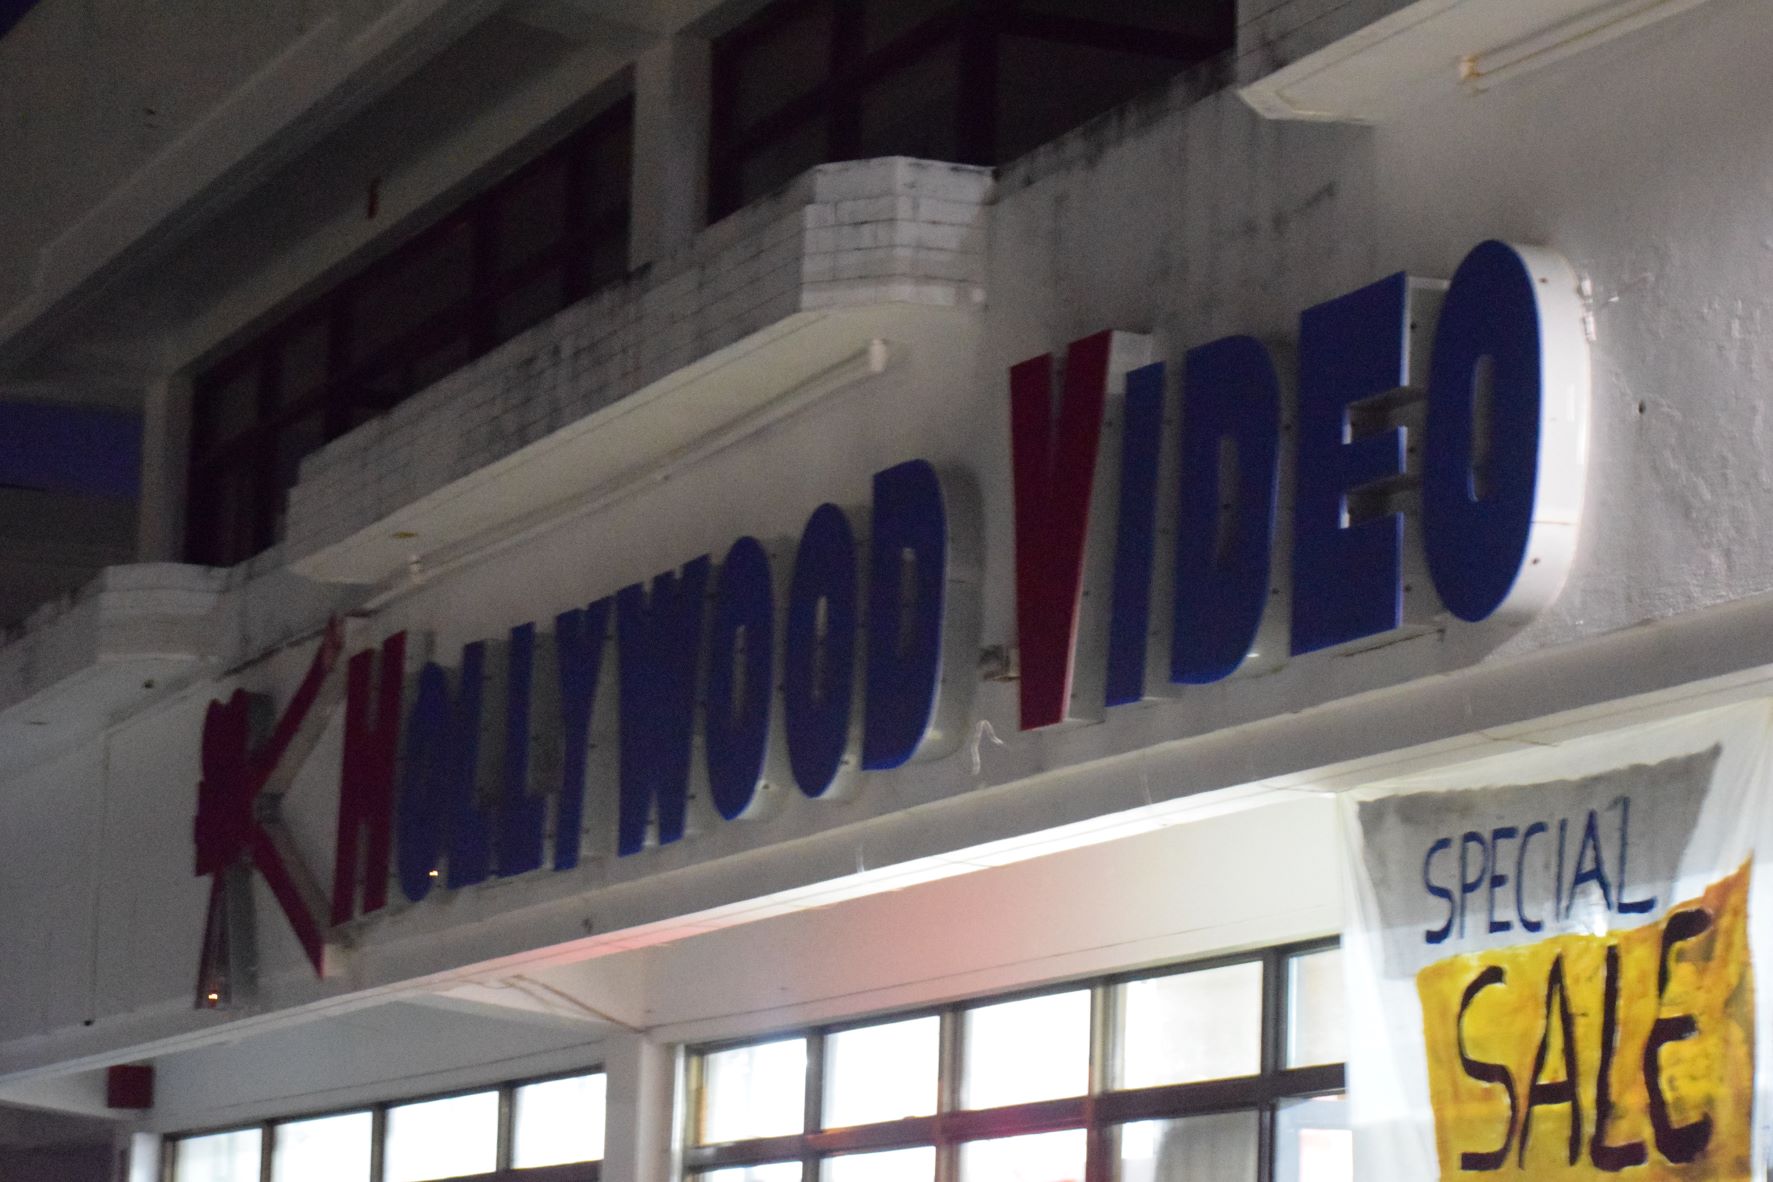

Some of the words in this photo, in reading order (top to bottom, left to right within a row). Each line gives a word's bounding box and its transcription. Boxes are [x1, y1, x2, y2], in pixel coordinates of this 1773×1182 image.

[1009, 238, 1544, 732] VIDEO
[1422, 795, 1659, 945] SPECIAL
[1456, 907, 1715, 1173] SALE
